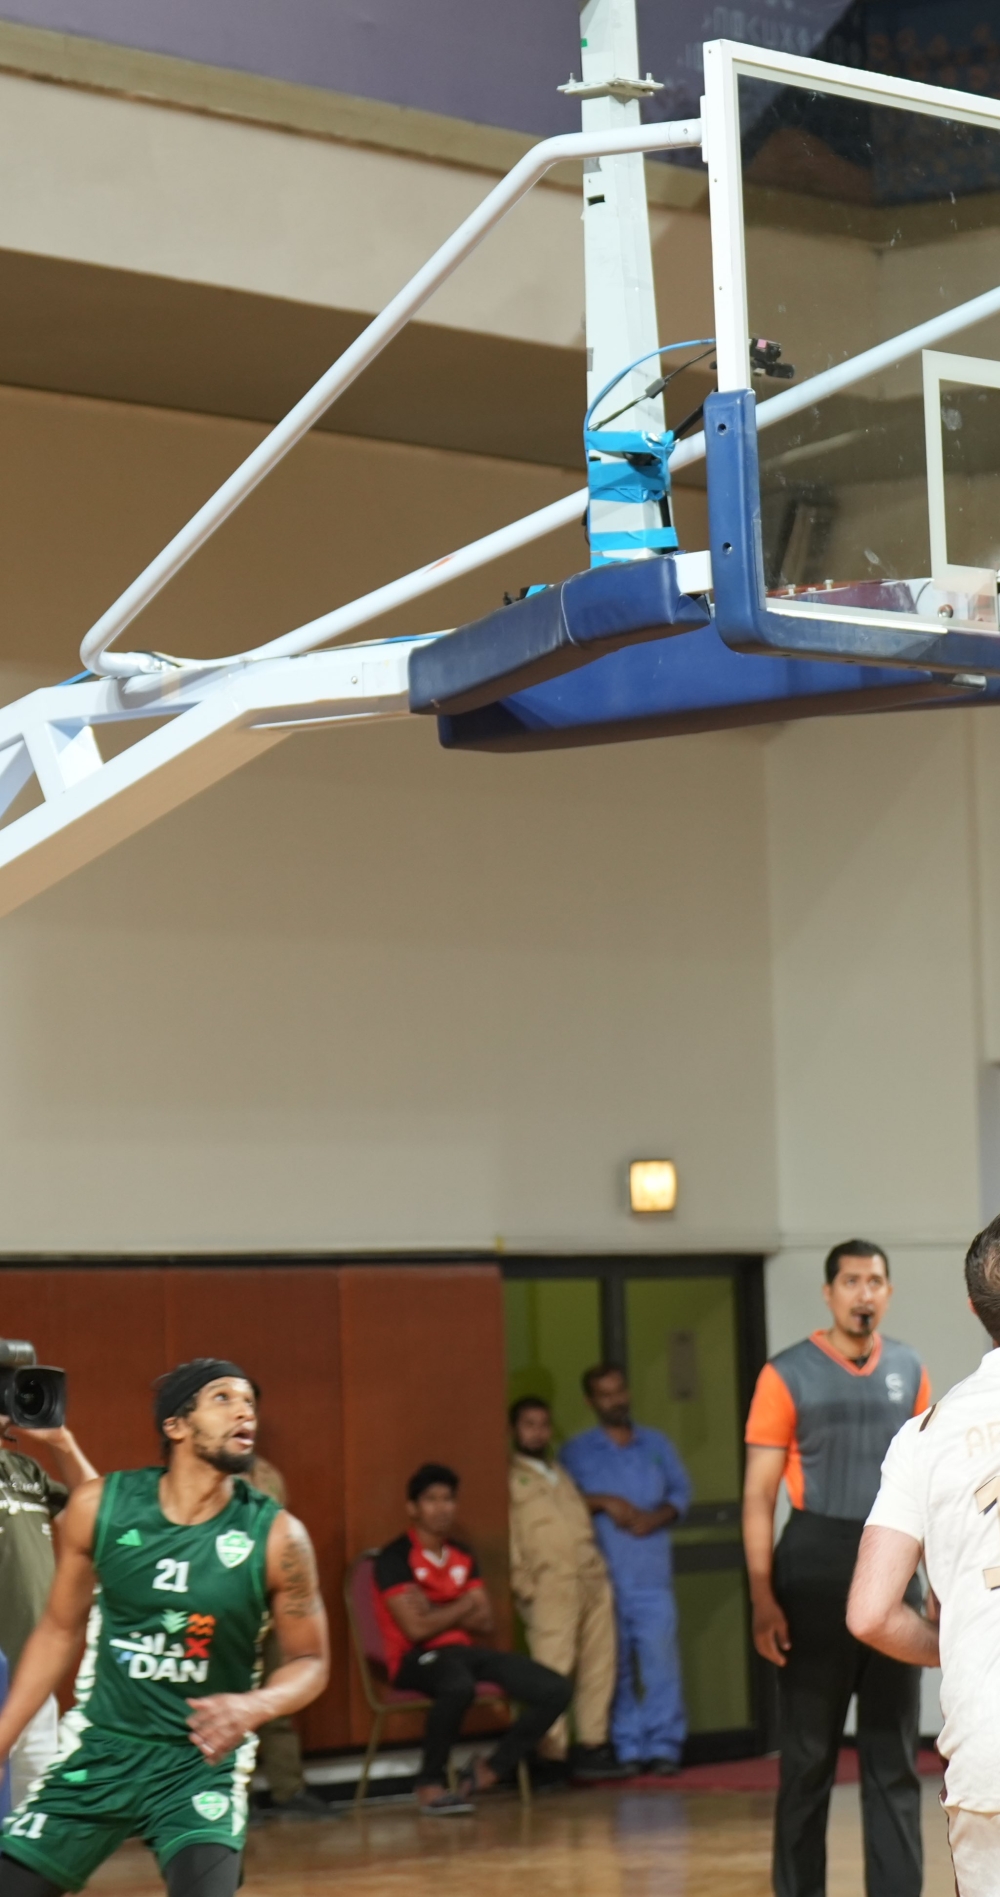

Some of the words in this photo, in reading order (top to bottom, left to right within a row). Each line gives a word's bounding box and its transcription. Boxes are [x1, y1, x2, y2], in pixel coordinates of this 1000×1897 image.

[152, 1558, 190, 1593] 21
[128, 1653, 209, 1683] DAN
[9, 1811, 48, 1839] 21
